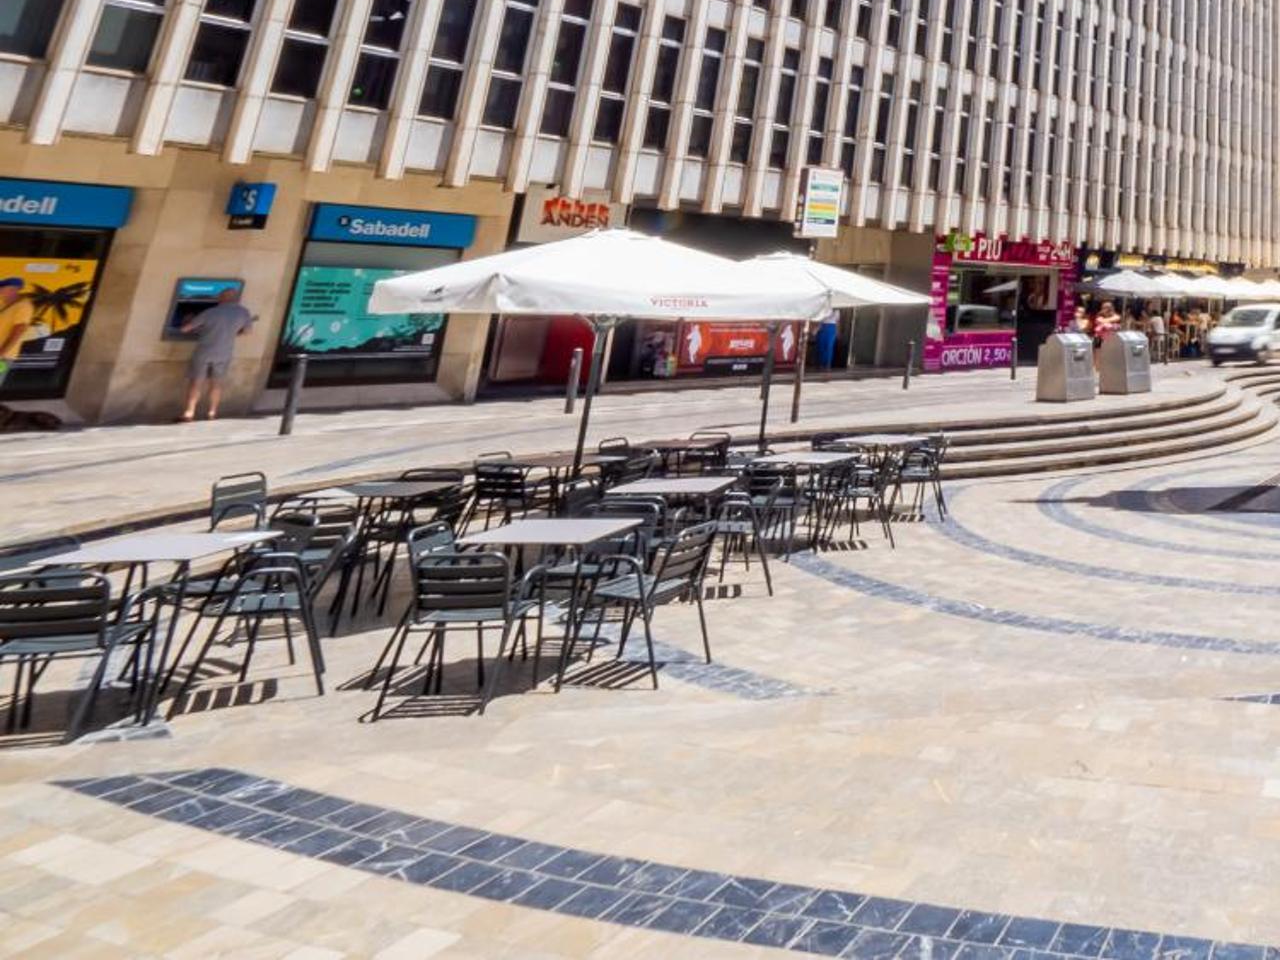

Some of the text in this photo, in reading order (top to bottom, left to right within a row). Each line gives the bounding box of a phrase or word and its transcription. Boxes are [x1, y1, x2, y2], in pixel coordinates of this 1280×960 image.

[0, 194, 58, 215] dell
[349, 218, 431, 239] Sabadell
[650, 297, 709, 308] VICTORIA
